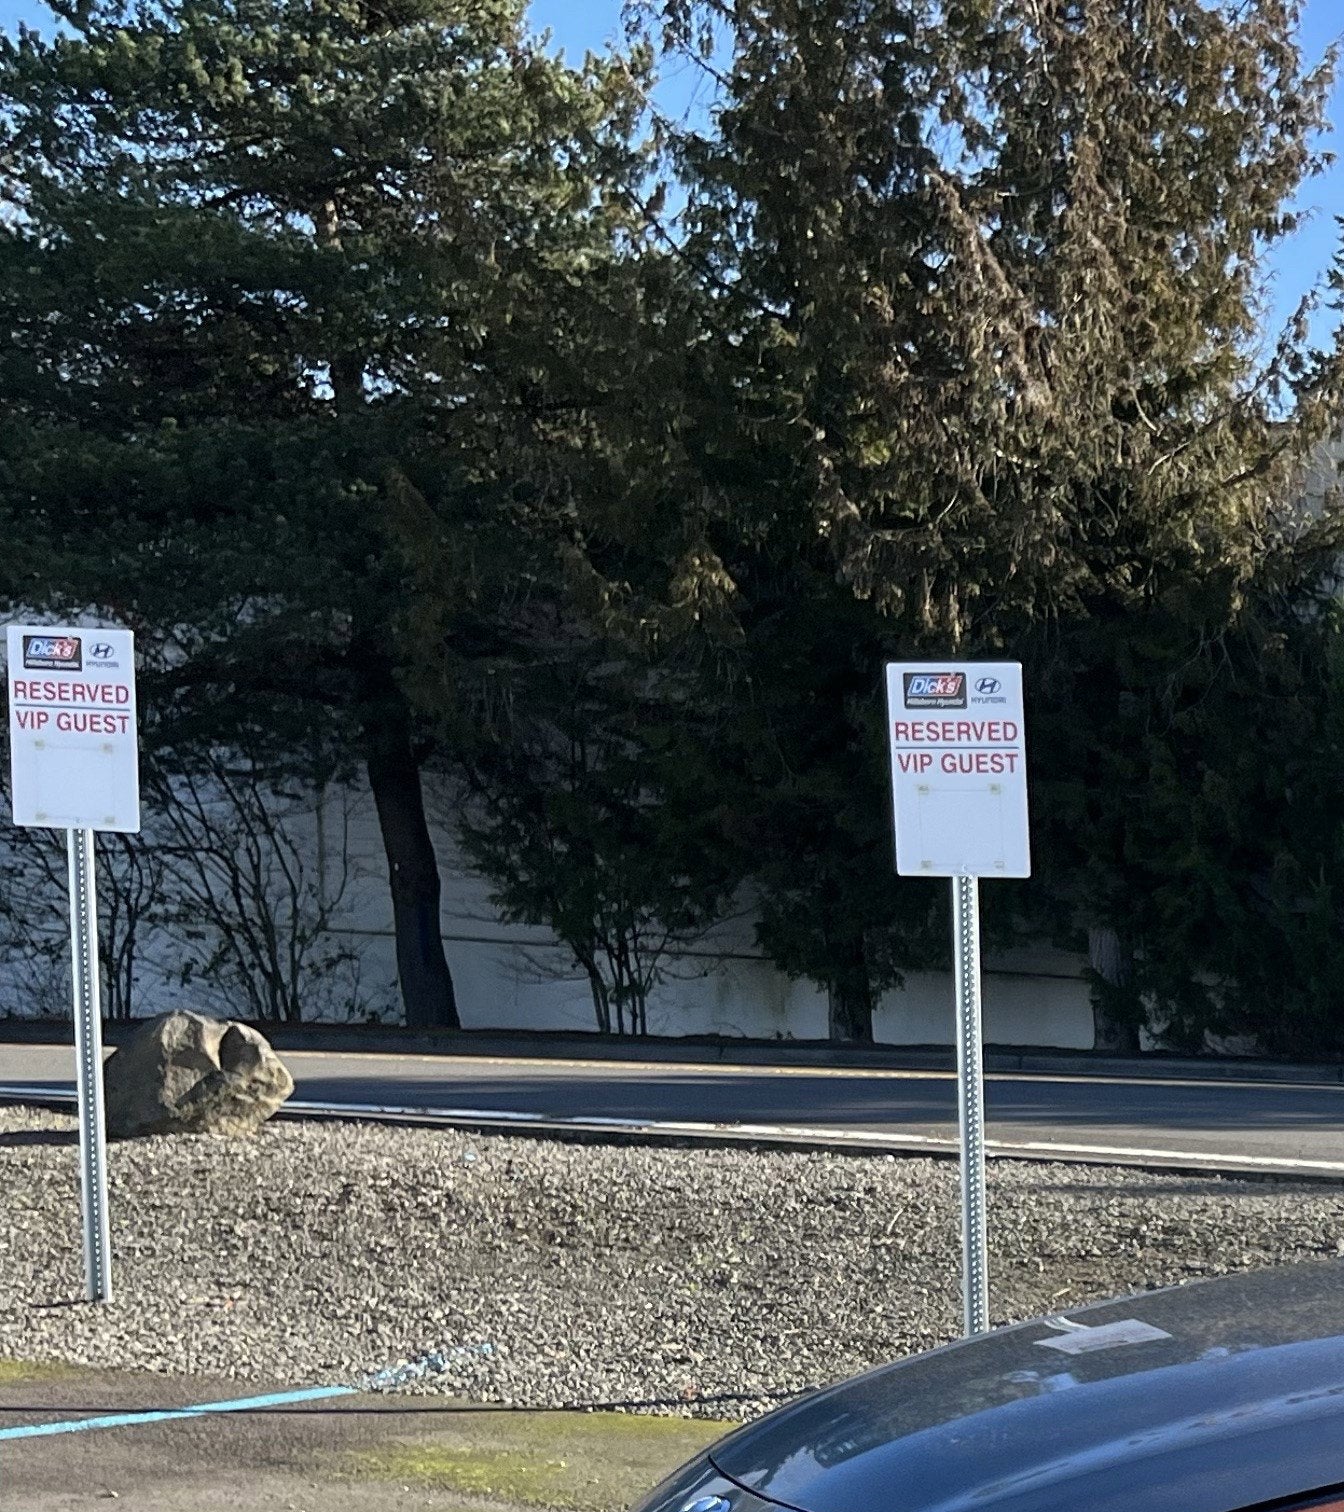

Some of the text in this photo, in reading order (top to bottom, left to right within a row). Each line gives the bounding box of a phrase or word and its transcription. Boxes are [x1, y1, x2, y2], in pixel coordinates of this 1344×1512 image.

[14, 680, 129, 704] RESERVED
[15, 711, 130, 734] VIP GUEST
[895, 721, 1018, 742] RESERVED
[898, 753, 1018, 774] VIP GUEST
